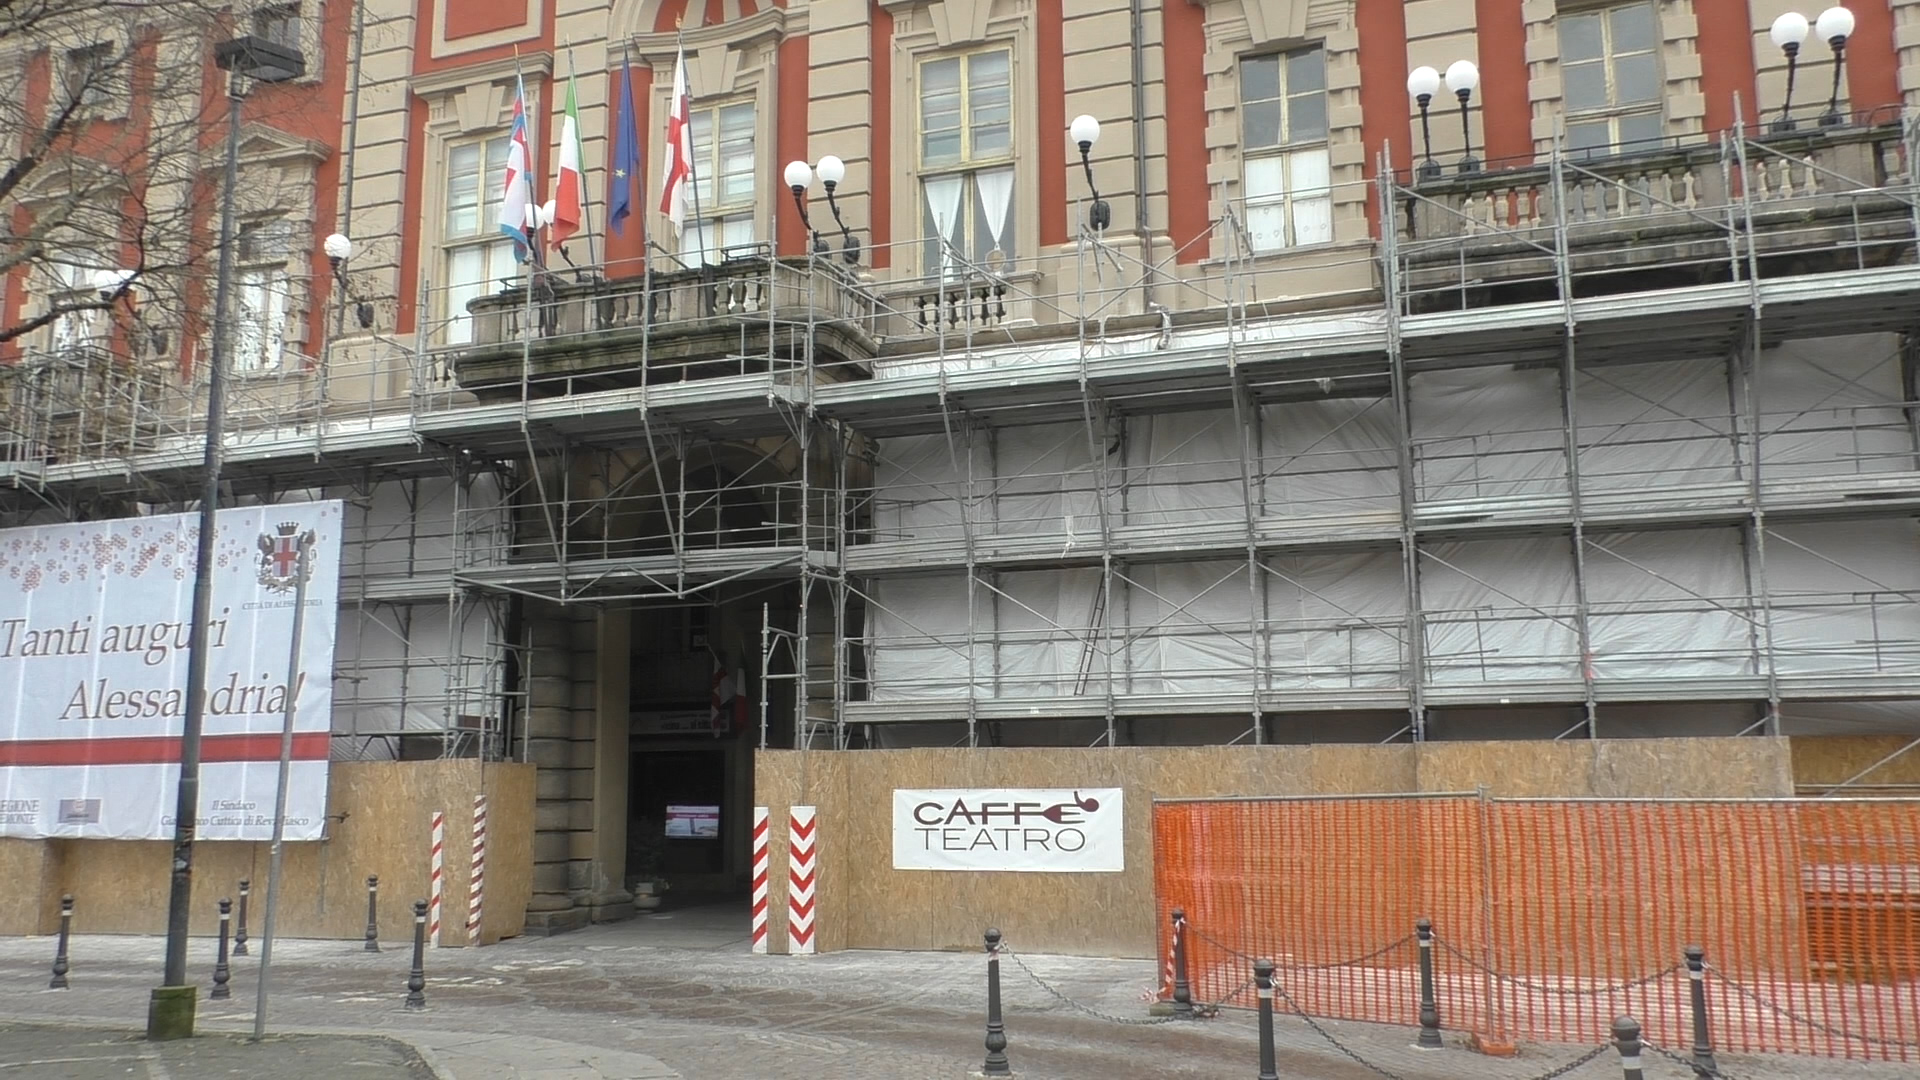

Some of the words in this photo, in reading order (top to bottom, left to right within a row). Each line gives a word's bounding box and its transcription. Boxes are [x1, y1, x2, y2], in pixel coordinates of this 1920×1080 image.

[0, 616, 92, 658] Tanti
[58, 671, 306, 720] Alessadria!
[244, 815, 254, 826] di
[914, 827, 1086, 852] TEATRO
